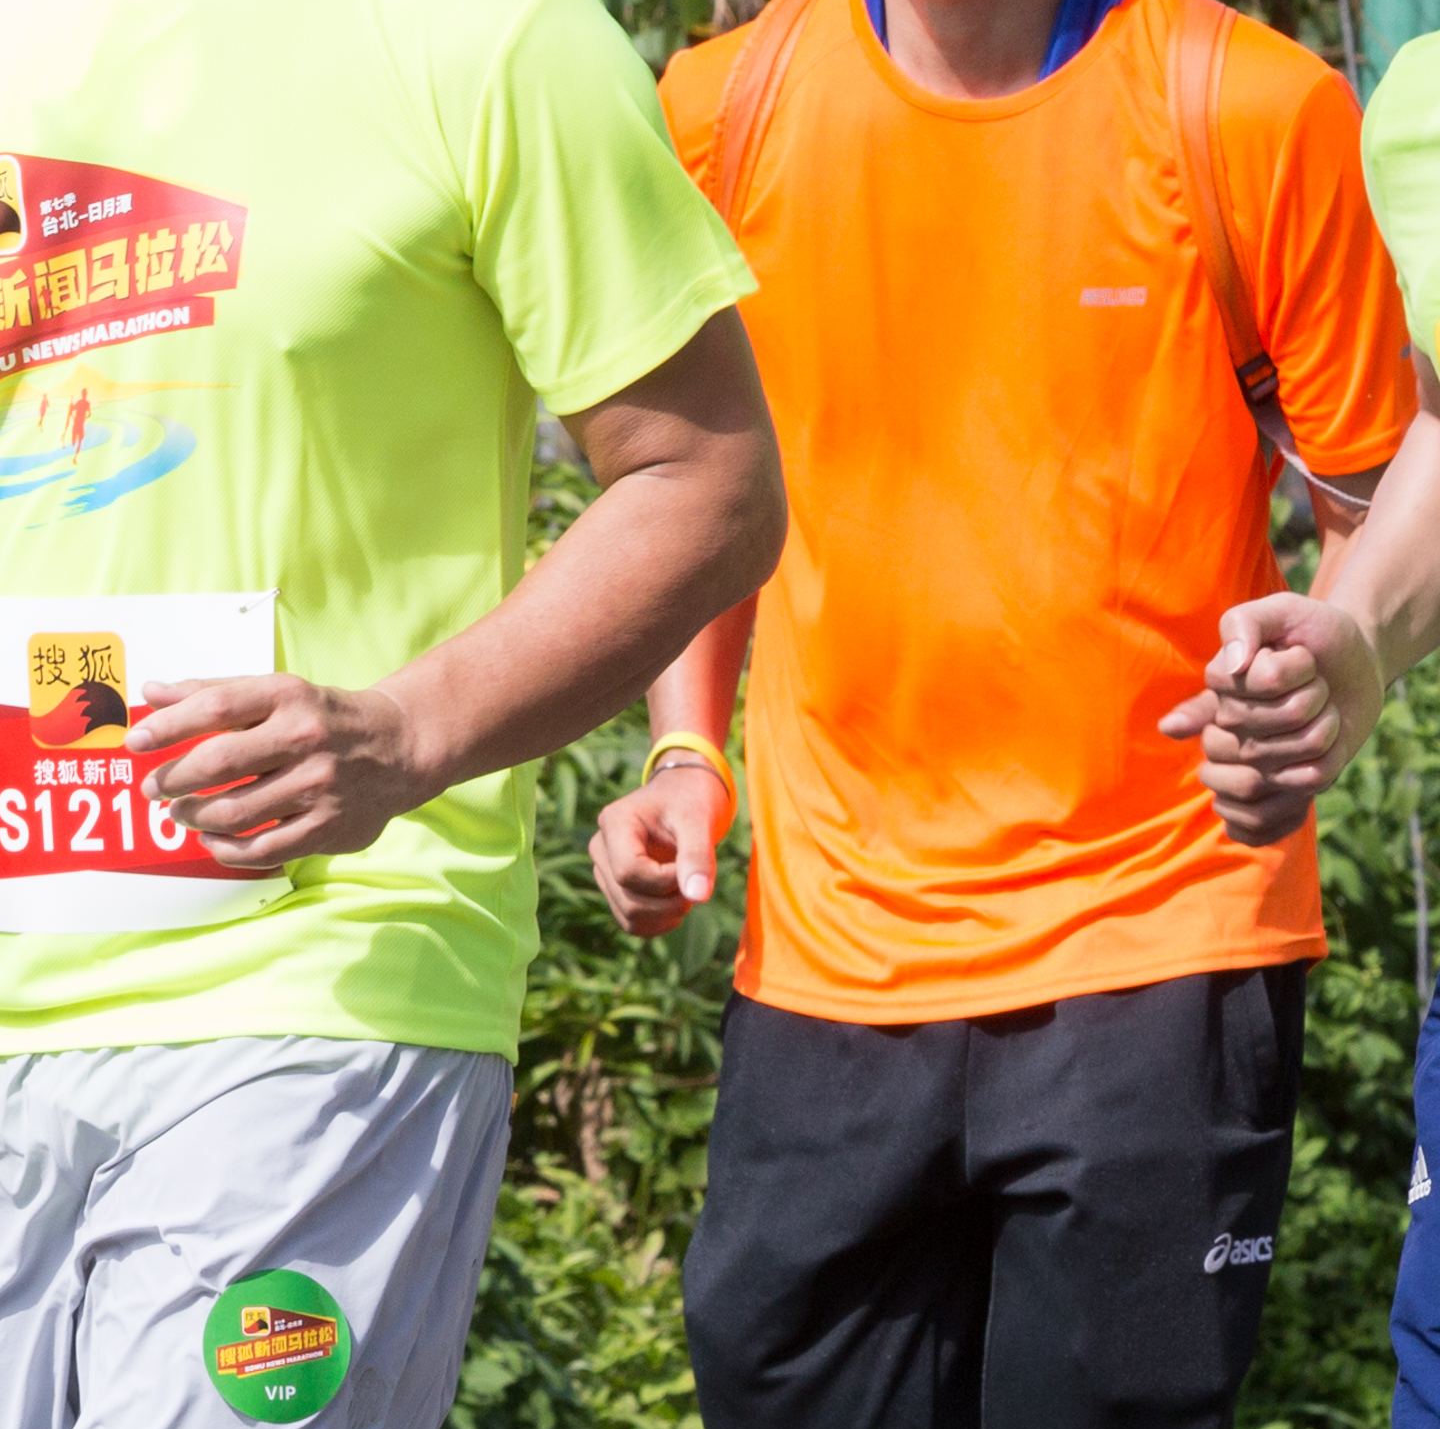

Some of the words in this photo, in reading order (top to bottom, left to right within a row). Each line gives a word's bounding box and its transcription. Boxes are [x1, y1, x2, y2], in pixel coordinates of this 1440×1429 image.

[40, 193, 76, 215] 第七季
[23, 330, 81, 364] NEWS
[80, 307, 190, 347] MARATHON
[33, 644, 121, 686] 搜狐
[34, 758, 133, 786] 搜狐新闻
[265, 1386, 296, 1401] VIP
